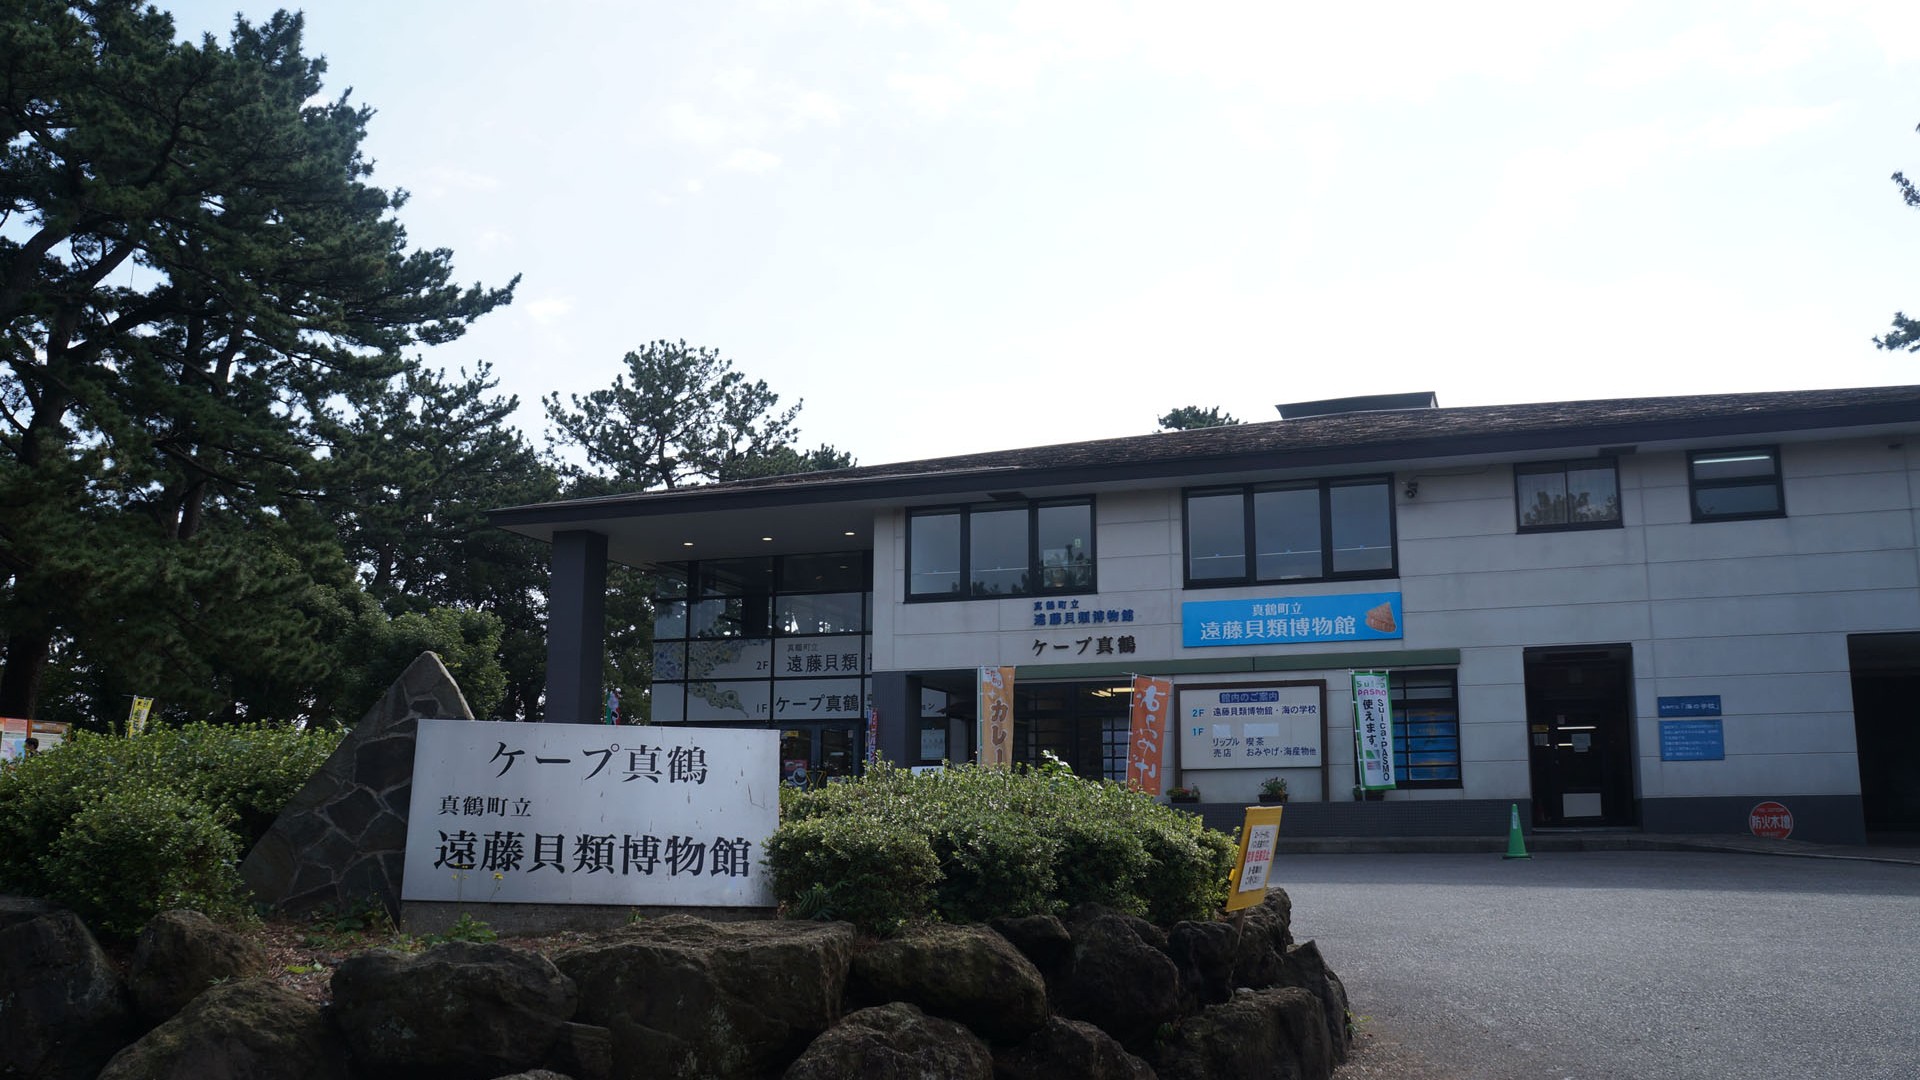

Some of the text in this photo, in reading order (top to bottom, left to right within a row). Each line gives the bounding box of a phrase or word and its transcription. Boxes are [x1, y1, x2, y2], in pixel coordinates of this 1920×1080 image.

[1034, 599, 1080, 611] 真鶴町立
[1252, 602, 1304, 616] 真鶴町立
[1033, 609, 1135, 627] 遠藤貝類博物館
[1200, 615, 1357, 641] 遠藤貝類博物館
[1032, 635, 1137, 657] ケープ真鶴
[756, 661, 769, 671] 2F
[776, 693, 859, 713] ケープ真鶴
[1220, 691, 1278, 703] 館内のご案内
[1191, 709, 1205, 718] 2F
[1191, 727, 1205, 736] 1F
[1212, 737, 1240, 747] リップル
[1212, 748, 1232, 758] 売店
[488, 741, 709, 785] ケープ真鶴
[437, 795, 533, 818] 真鶴町立
[433, 828, 753, 878] 遠藤貝類博物館
